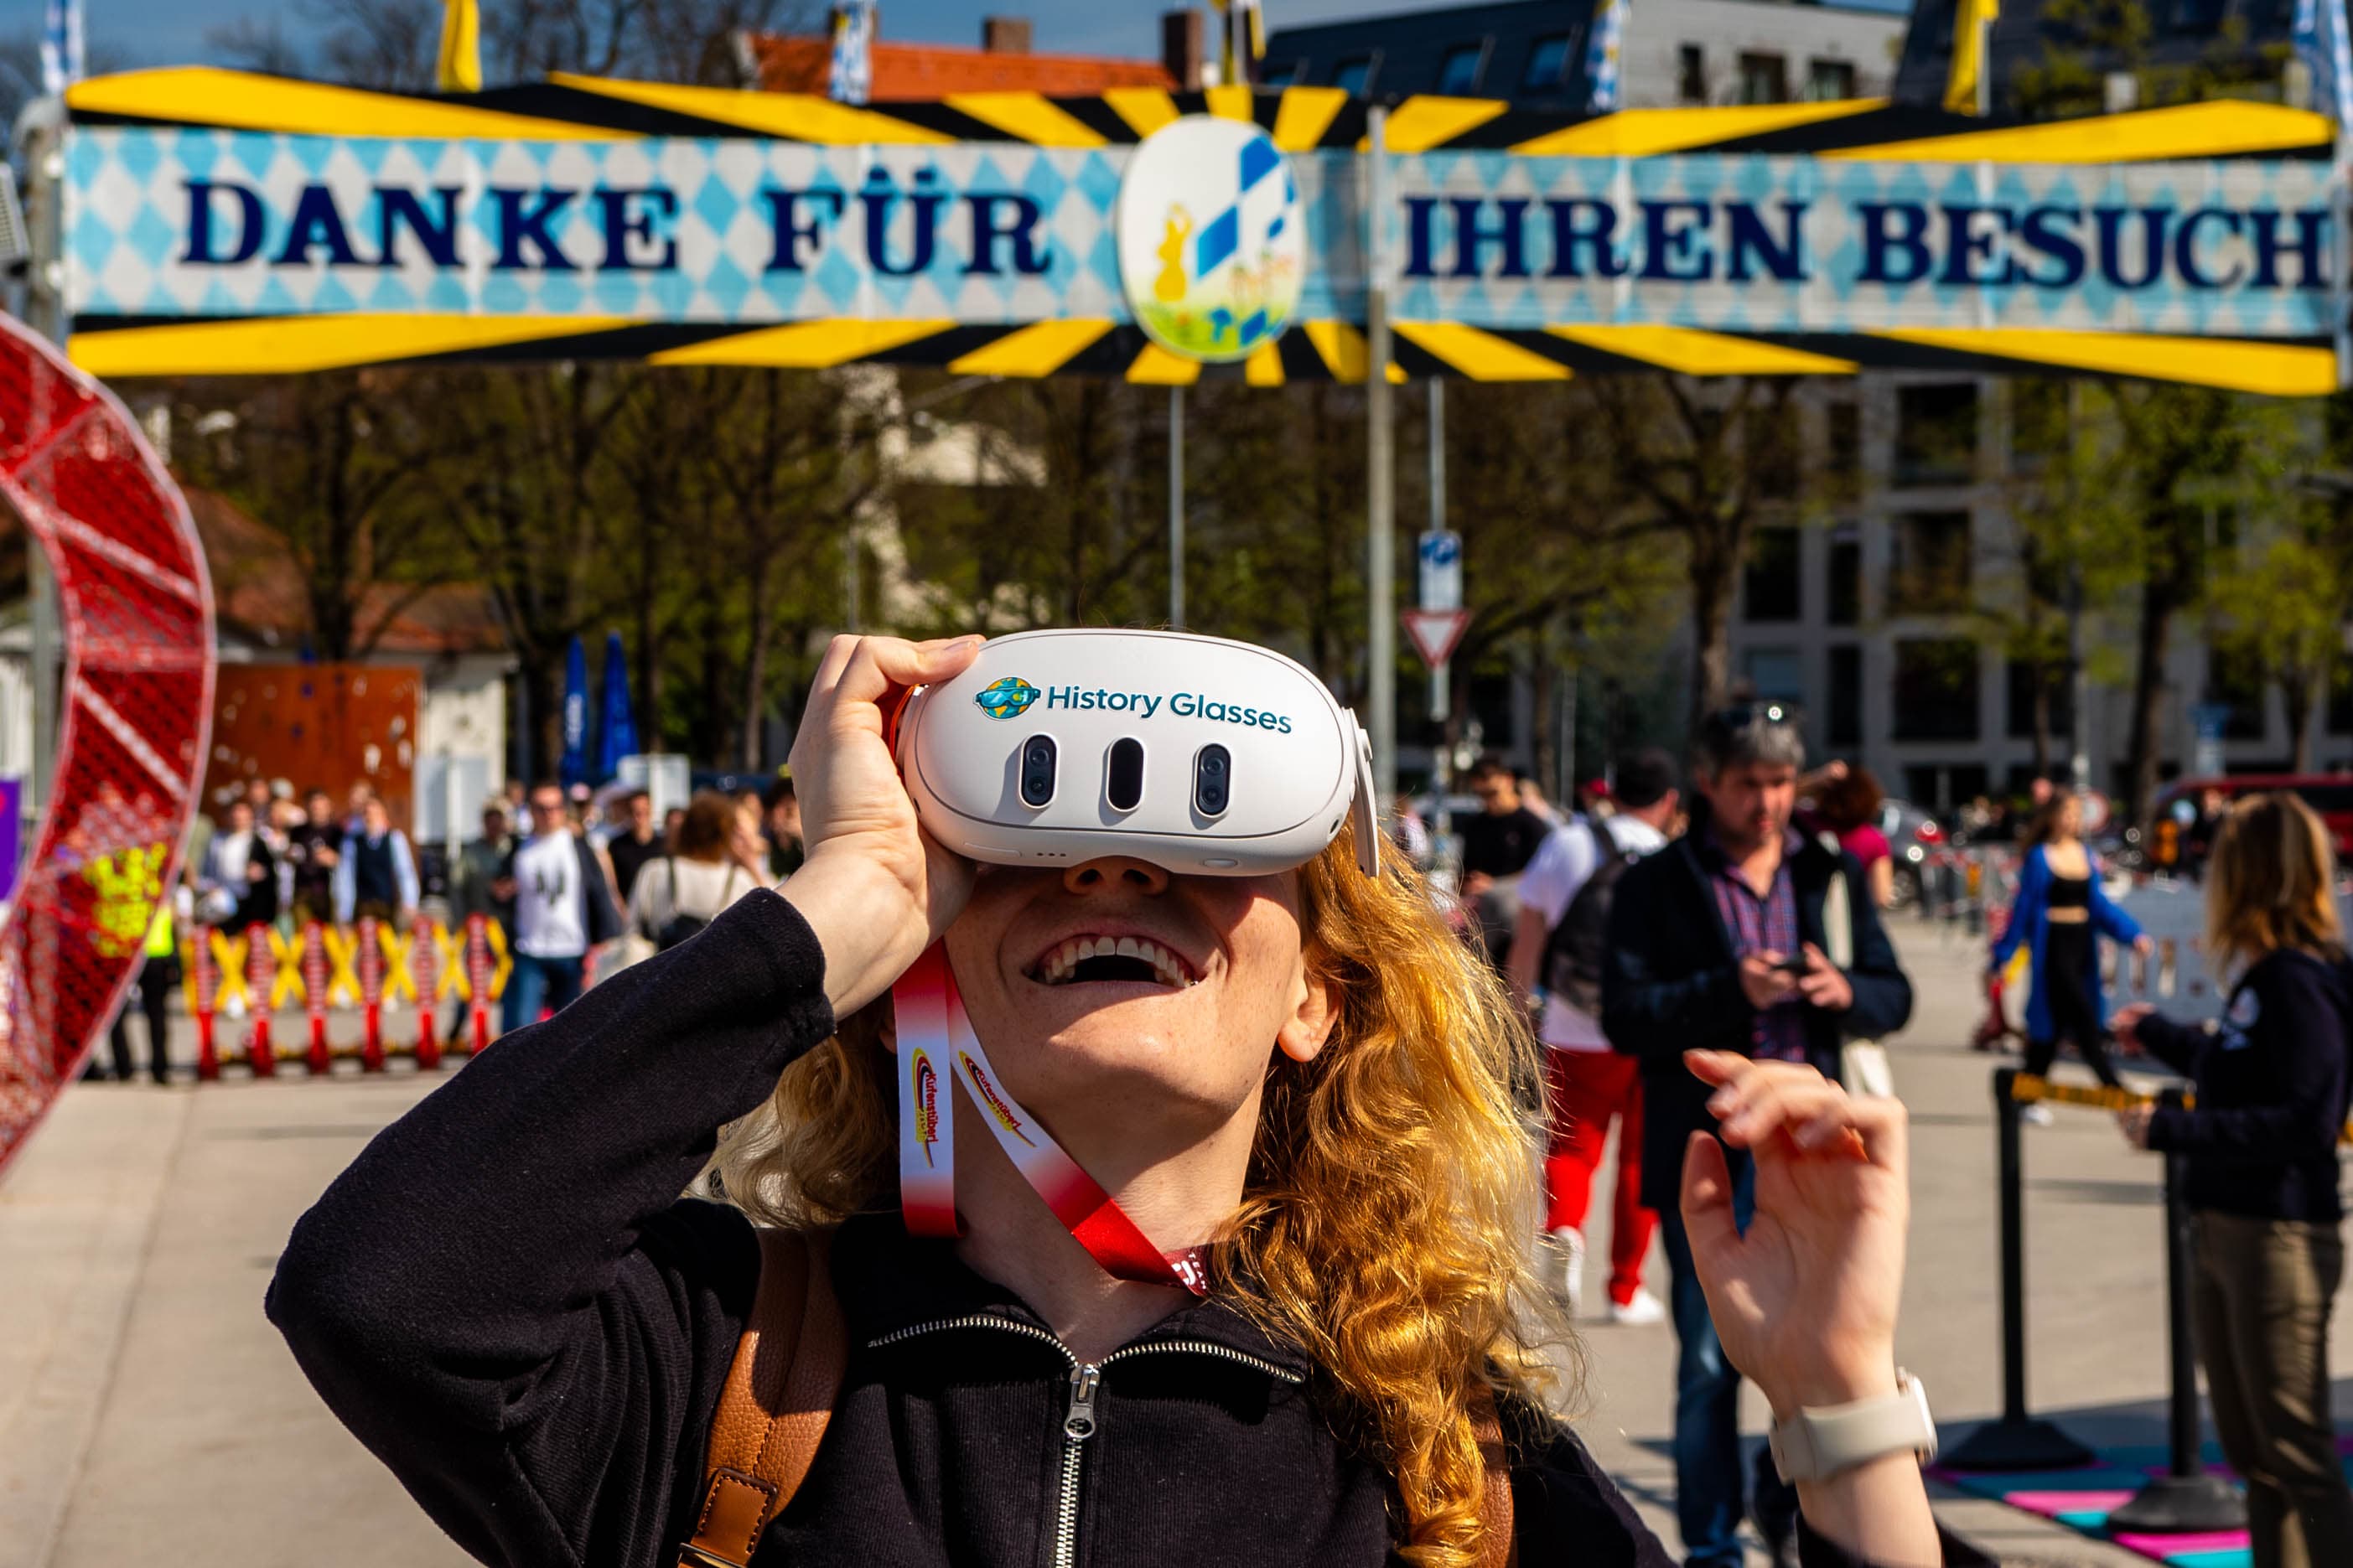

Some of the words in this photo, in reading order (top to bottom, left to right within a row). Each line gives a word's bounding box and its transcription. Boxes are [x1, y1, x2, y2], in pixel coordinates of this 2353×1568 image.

[180, 179, 679, 272] DANKE
[764, 168, 1052, 276] FÜR
[1402, 198, 1807, 283] IHREN
[1857, 203, 2333, 292] BESUCH
[1047, 686, 1163, 719] History
[1170, 692, 1292, 734] Glasses
[925, 1073, 939, 1143] Kufenstüberl
